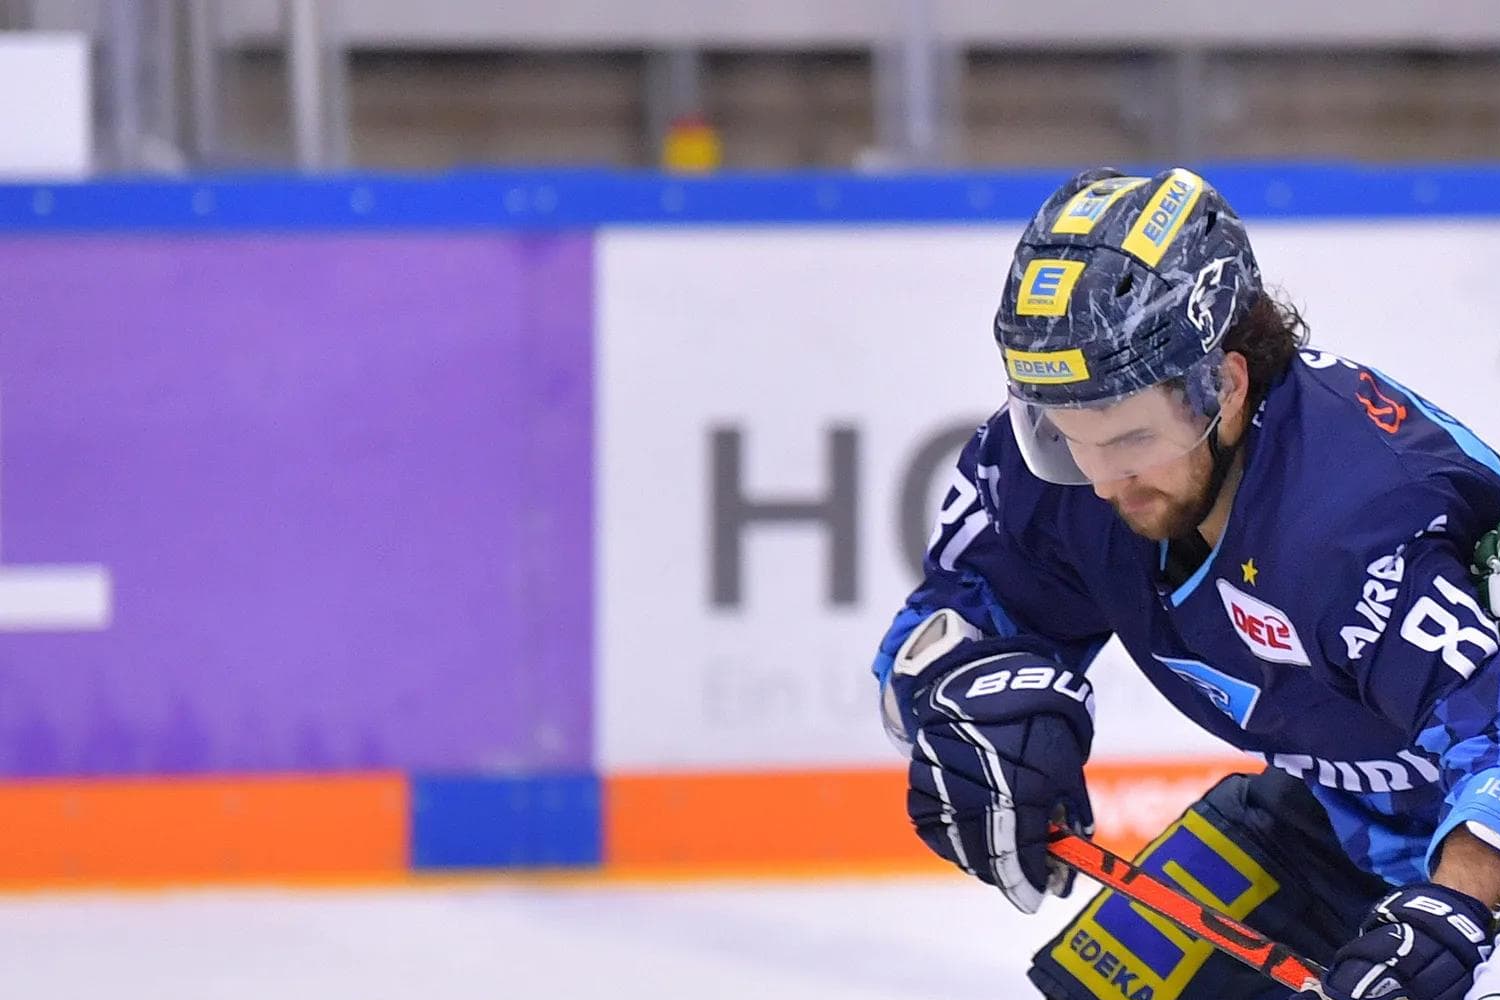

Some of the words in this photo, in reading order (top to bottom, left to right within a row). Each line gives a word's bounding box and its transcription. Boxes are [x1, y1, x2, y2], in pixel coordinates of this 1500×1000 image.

[1142, 179, 1192, 243] EDEKA
[1031, 267, 1066, 296] E
[1014, 359, 1072, 374] EDEKA
[1400, 575, 1500, 681] 81
